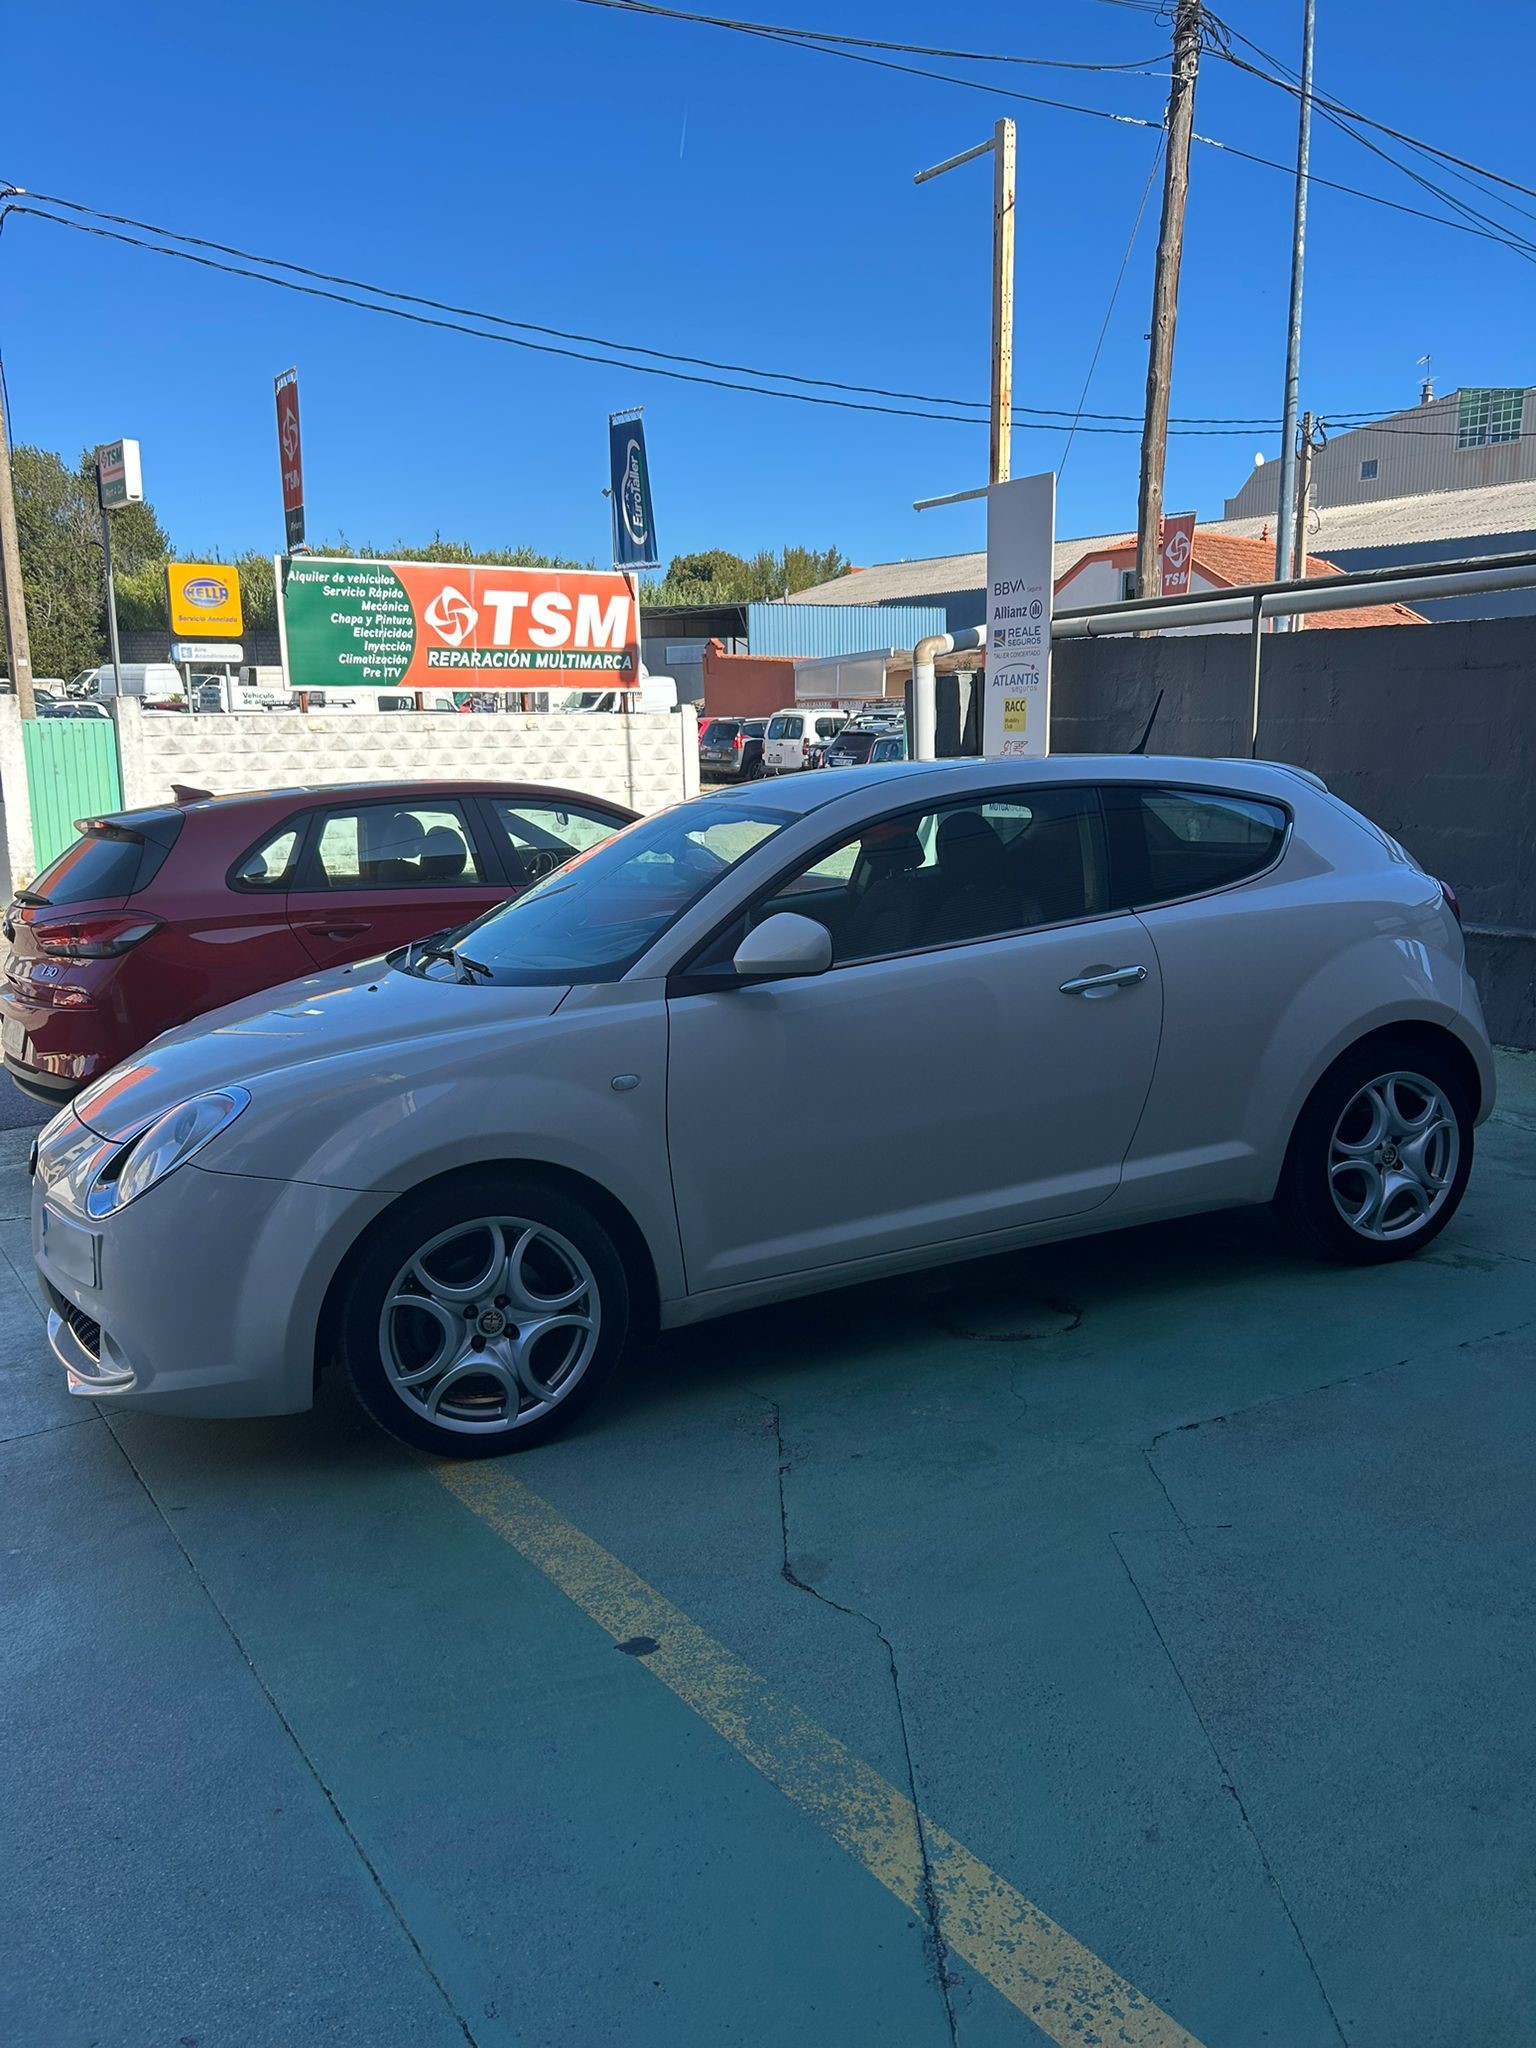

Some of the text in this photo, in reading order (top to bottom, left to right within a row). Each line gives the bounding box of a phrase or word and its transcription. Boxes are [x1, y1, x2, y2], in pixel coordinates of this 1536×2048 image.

[107, 447, 122, 467] TSM
[628, 455, 643, 528] EuroTaller
[288, 570, 396, 585] Alquiler de vehículos
[186, 587, 228, 600] HELLA
[323, 585, 404, 600] Servicio Rápido
[994, 578, 1025, 596] BBVA
[361, 600, 409, 612] Mecánica
[331, 613, 413, 626] Chapa y Pintura
[483, 589, 631, 648] TSM
[994, 606, 1027, 620] Allianz
[353, 627, 414, 639] Electricidad
[1008, 625, 1041, 638] REALE
[364, 641, 412, 653] Inyección
[1008, 637, 1041, 647] SEGUROS
[338, 653, 408, 665] Climatización
[428, 650, 632, 669] REPARACIÓN MULTIMARCA
[363, 667, 402, 678] Pre ITV
[992, 672, 1040, 687] ATLANTIS
[1011, 685, 1038, 693] seguros
[1005, 700, 1025, 712] RACC
